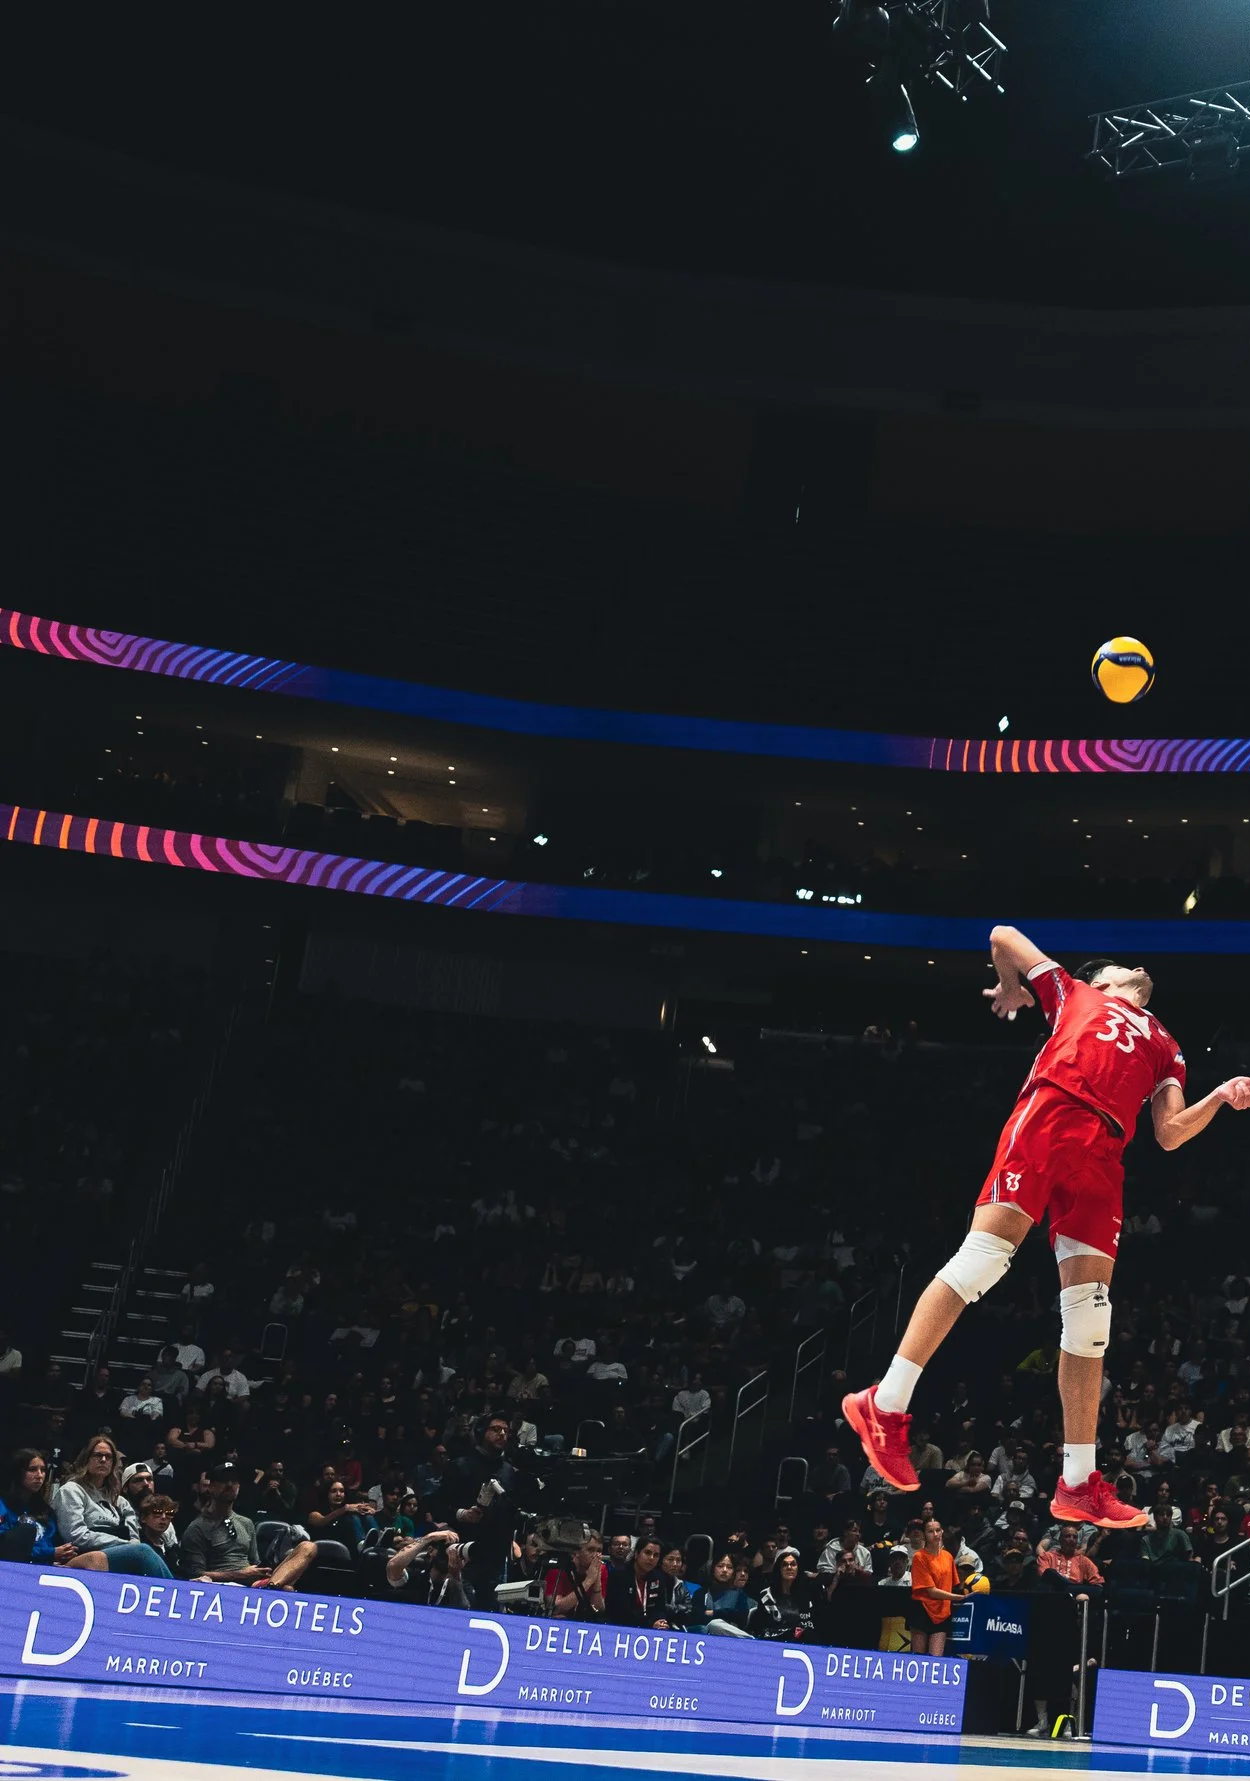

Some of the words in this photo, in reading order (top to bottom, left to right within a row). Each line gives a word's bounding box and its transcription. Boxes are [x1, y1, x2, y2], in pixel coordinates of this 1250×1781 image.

[1096, 1010, 1142, 1054] 33
[1006, 1172, 1021, 1191] 33
[118, 1583, 223, 1623] DELTA
[240, 1596, 365, 1635] HOTELS
[525, 1624, 603, 1657] DELTA
[614, 1633, 706, 1665] HOTELS
[105, 1655, 208, 1678] MARRIOTT
[826, 1653, 884, 1680] DELTA
[892, 1659, 961, 1686] HOTELS
[287, 1668, 353, 1688] QUÉBEC
[518, 1686, 593, 1705] MARRIOTT
[649, 1693, 699, 1711] QUÉBEC
[821, 1707, 876, 1722] MARRIOTT
[919, 1711, 956, 1726] QUÉBEC
